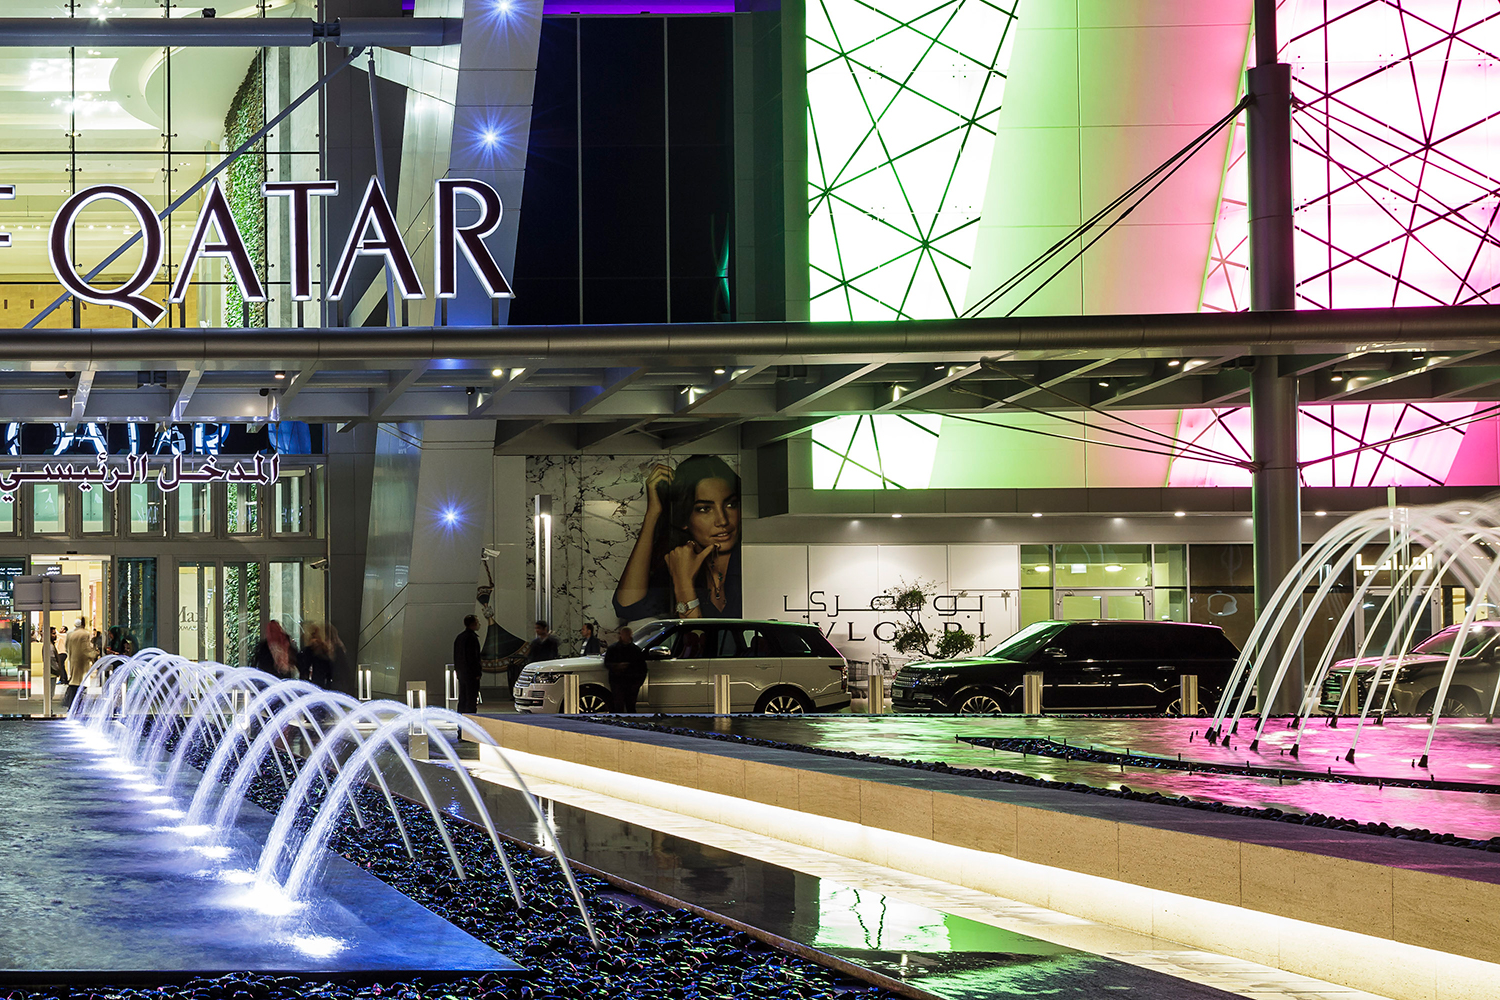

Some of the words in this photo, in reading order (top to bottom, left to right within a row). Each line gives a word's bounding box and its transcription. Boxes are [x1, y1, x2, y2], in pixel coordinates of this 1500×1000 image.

[48, 175, 517, 328] QATAR
[156, 451, 280, 492] المدخل
[811, 621, 987, 642] VLGRI
